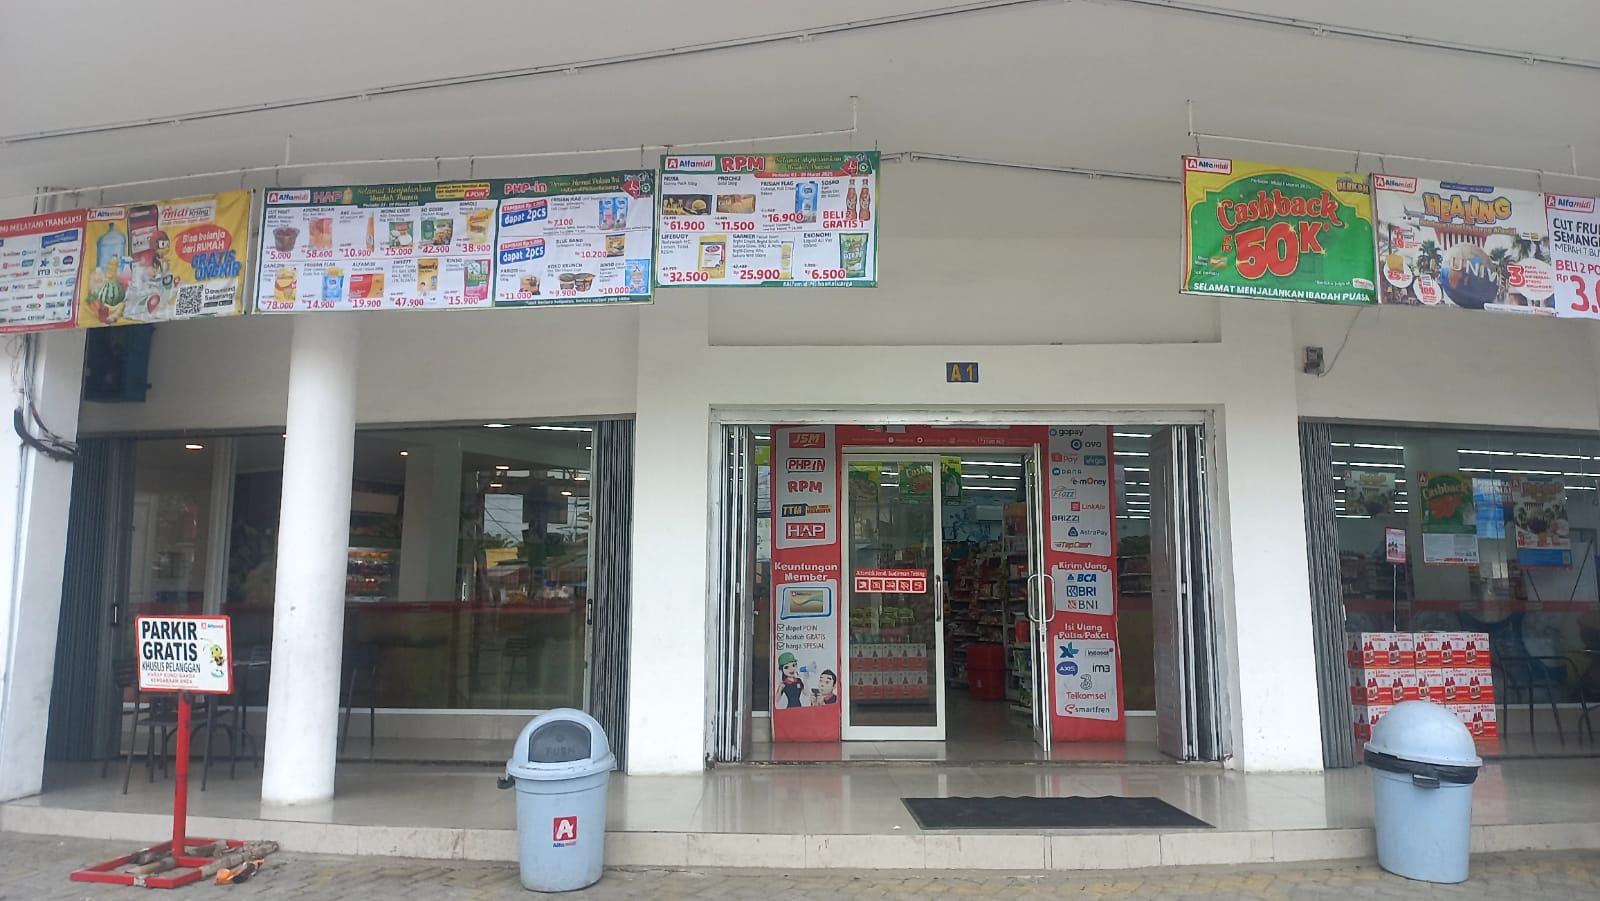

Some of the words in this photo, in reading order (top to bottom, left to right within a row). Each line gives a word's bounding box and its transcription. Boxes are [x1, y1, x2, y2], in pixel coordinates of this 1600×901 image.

[680, 160, 713, 168] Alfamidi
[721, 156, 766, 172] RPM
[1199, 160, 1229, 171] Alfamidi
[503, 180, 548, 196] PHP-in
[1386, 179, 1413, 189] Alfamidi
[312, 191, 342, 204] HAP
[1217, 189, 1343, 231] Cashback
[1421, 192, 1513, 225] HEALING
[1557, 199, 1592, 210] Alfamidi
[504, 212, 525, 225] dapat
[527, 207, 547, 222] 2pcs
[768, 213, 804, 223] 16.900
[823, 212, 845, 220] BELI
[45, 216, 82, 228] TRANSAKSI
[670, 221, 705, 231] 61.900
[721, 221, 755, 231] 11.500
[823, 220, 858, 229] GRATIS
[1553, 217, 1573, 232] CUT
[198, 229, 226, 242] belanja
[182, 243, 197, 253] dari
[197, 240, 225, 252] RUMAH
[385, 247, 413, 256] 15.000
[422, 245, 451, 254] 42.500
[462, 243, 492, 253] 38.900
[1235, 221, 1323, 280] 50K
[1554, 243, 1582, 256] MERAH
[269, 250, 292, 260] 5.000
[305, 250, 334, 259] 58.600
[343, 248, 372, 258] 10.900
[502, 251, 523, 263] dapat
[525, 246, 545, 260] 2pcs
[581, 250, 608, 259] 10.200
[192, 251, 236, 269] GRATIS
[1555, 259, 1579, 273] BELI
[1579, 262, 1586, 274] 2
[669, 271, 709, 283] 32.500
[740, 269, 781, 280] 25.900
[811, 269, 846, 280] 6.500
[1507, 264, 1525, 287] 3
[1556, 273, 1569, 284] Rp
[505, 292, 532, 300] 11.000
[555, 289, 577, 298] 9.900
[603, 287, 630, 295] 10.000
[1193, 281, 1236, 293] SELAMAT
[1236, 285, 1306, 299] MENJALANKAN
[1306, 288, 1341, 301] IBADAH
[1342, 291, 1370, 302] PUASA
[266, 301, 294, 310] 78.000
[307, 300, 335, 309] 14.900
[351, 299, 382, 309] 19.900
[395, 298, 425, 308] 47.900
[448, 296, 479, 306] 15.900
[793, 433, 821, 444] JSM
[787, 480, 823, 493] RPM
[783, 506, 803, 516] TTM
[1051, 513, 1081, 523] BRIZZI
[787, 525, 825, 538] HAP
[1079, 528, 1109, 537] AstraPay
[774, 561, 838, 573] Keuntungan
[1058, 561, 1083, 571] Kirim
[1084, 563, 1108, 573] Uang
[784, 573, 828, 582] Member
[1077, 573, 1098, 583] BCA
[1078, 586, 1097, 597] BRI
[1078, 599, 1099, 610] BNI
[141, 620, 198, 641] PARKIR
[786, 624, 802, 632] dapat
[1065, 622, 1077, 632] Isi
[1077, 622, 1103, 634] Ulang
[806, 633, 826, 641] GRATIS
[142, 641, 198, 662] GRATIS
[786, 642, 802, 651] harga
[142, 661, 165, 673] KHUSUS
[165, 662, 201, 673] PELANGGAN
[1092, 663, 1111, 673] im3
[1066, 691, 1107, 700] Telkomsel
[1075, 706, 1110, 714] smartfren
